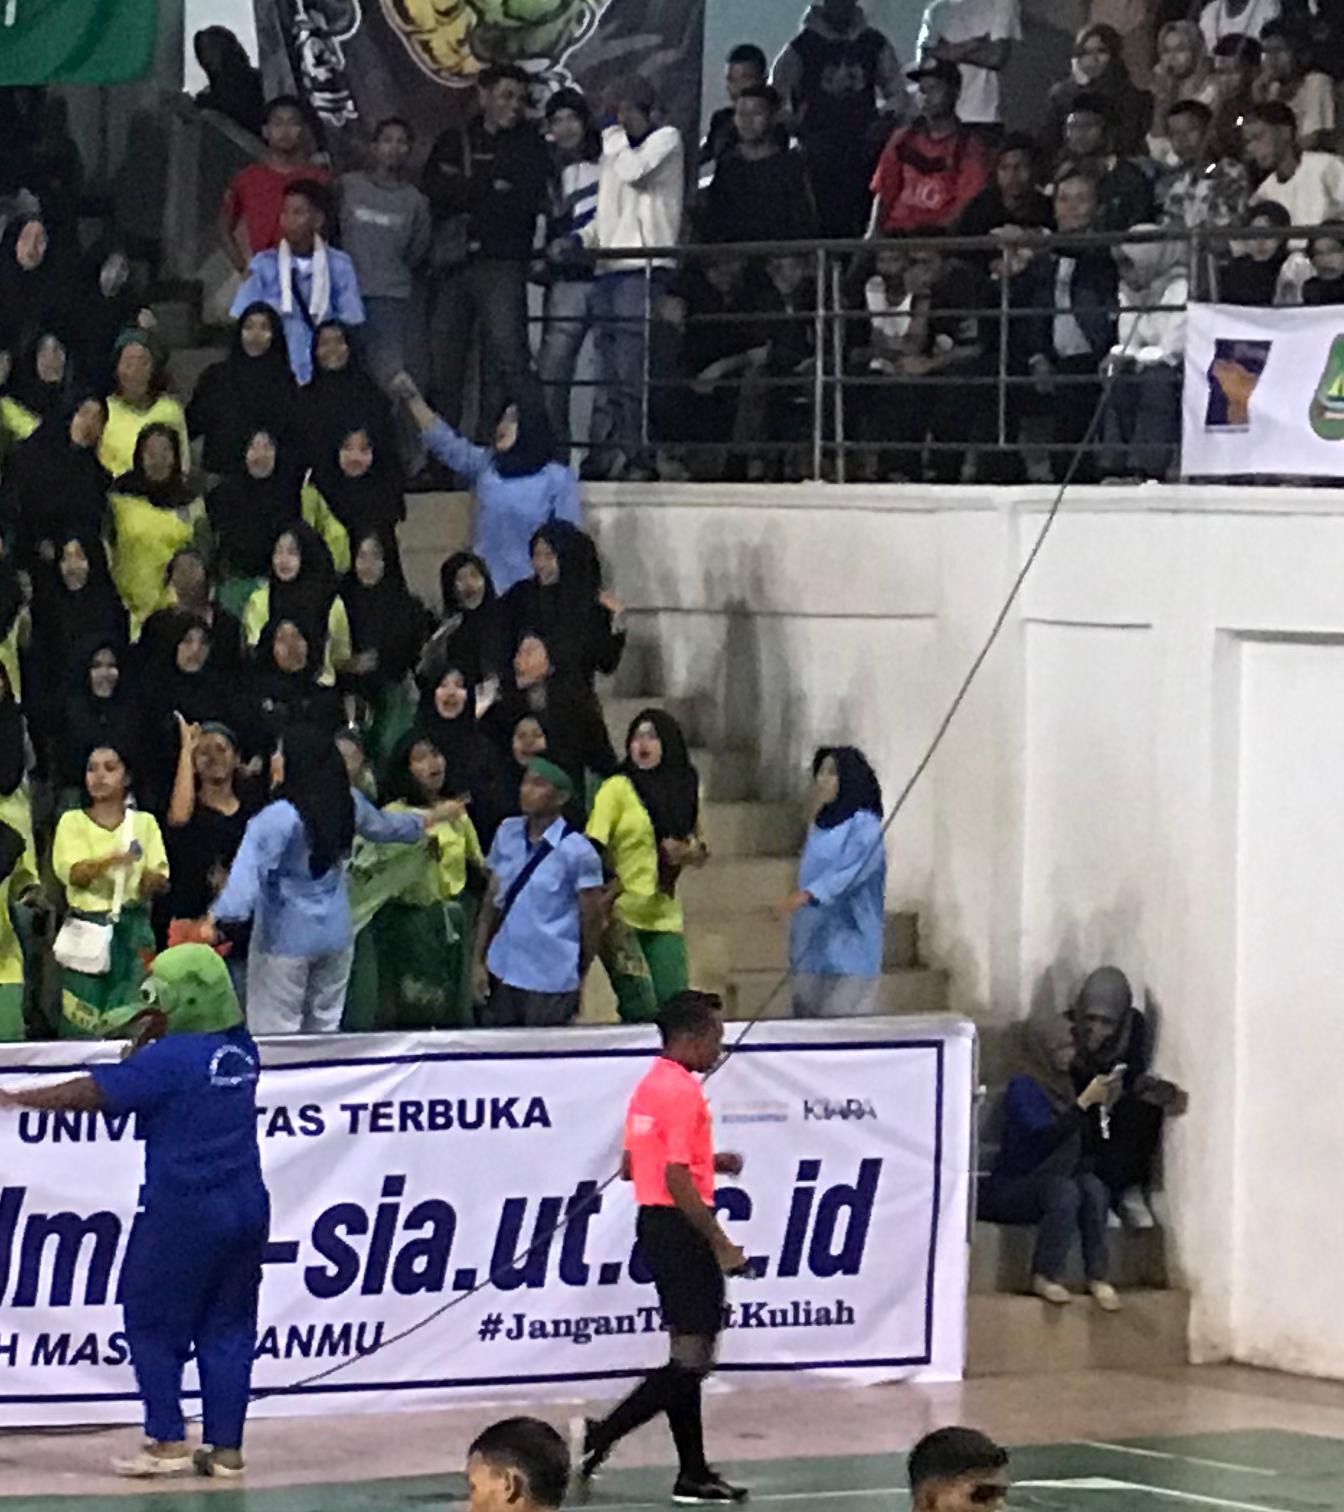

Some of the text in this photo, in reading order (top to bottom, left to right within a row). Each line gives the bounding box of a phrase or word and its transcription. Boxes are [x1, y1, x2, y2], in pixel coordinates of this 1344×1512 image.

[18, 1096, 551, 1144] UNIVAS TERBUKA
[478, 1300, 855, 1344] #JanganTtKuliah
[30, 1332, 137, 1367] MAS
